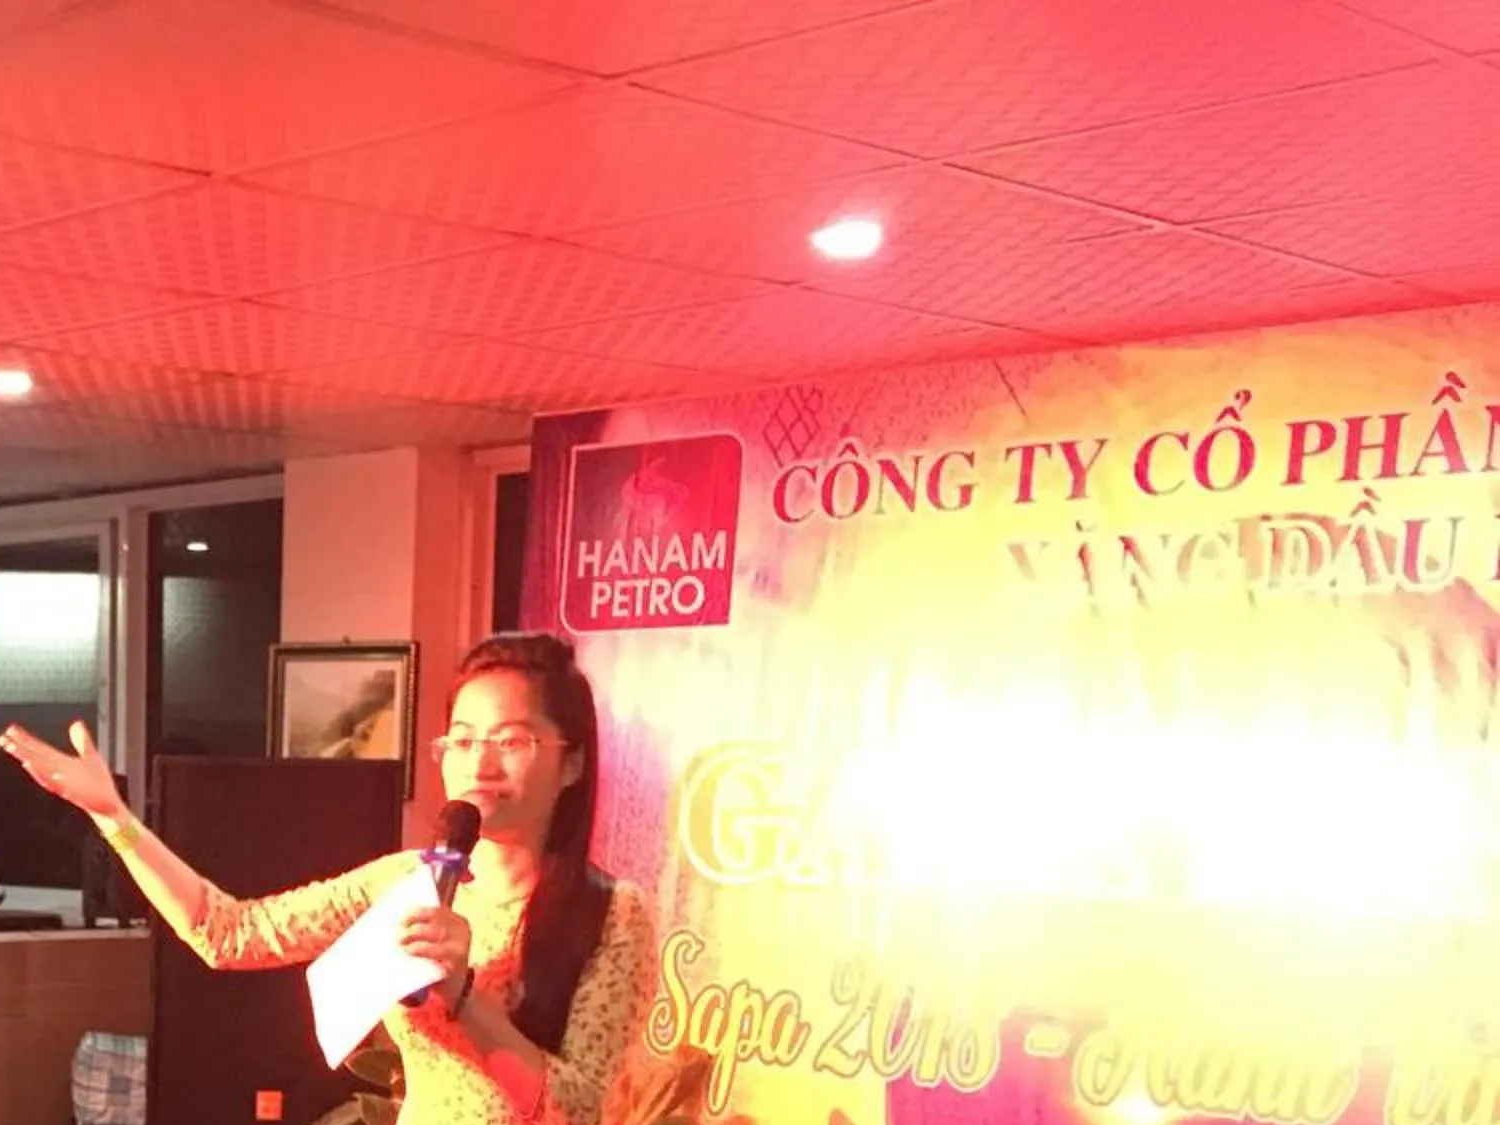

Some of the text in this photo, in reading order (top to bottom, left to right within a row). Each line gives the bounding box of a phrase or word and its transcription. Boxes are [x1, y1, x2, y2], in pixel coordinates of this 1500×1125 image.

[771, 442, 980, 524] CÔNG
[1003, 438, 1109, 504] TY
[1132, 388, 1257, 496] CỔ
[577, 529, 728, 578] HANAM
[590, 575, 706, 619] PETRO
[647, 929, 812, 1117] Sapa
